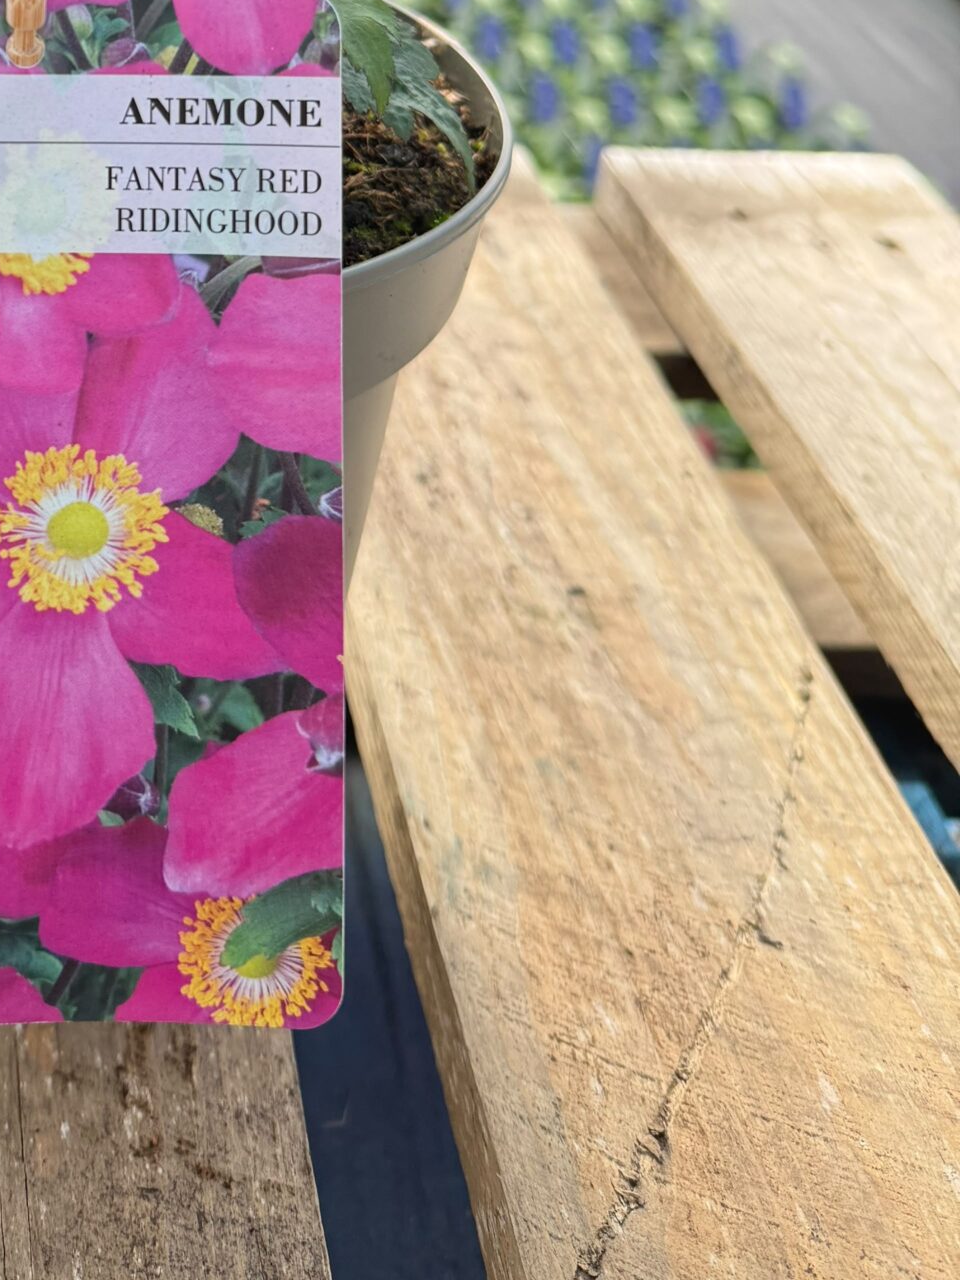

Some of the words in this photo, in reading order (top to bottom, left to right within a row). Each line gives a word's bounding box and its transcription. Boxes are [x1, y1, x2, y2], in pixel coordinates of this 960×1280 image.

[119, 96, 322, 128] ANEMONE
[105, 165, 248, 193] FANTASY
[256, 168, 322, 194] RED
[115, 207, 322, 236] RIDINGHOOD
